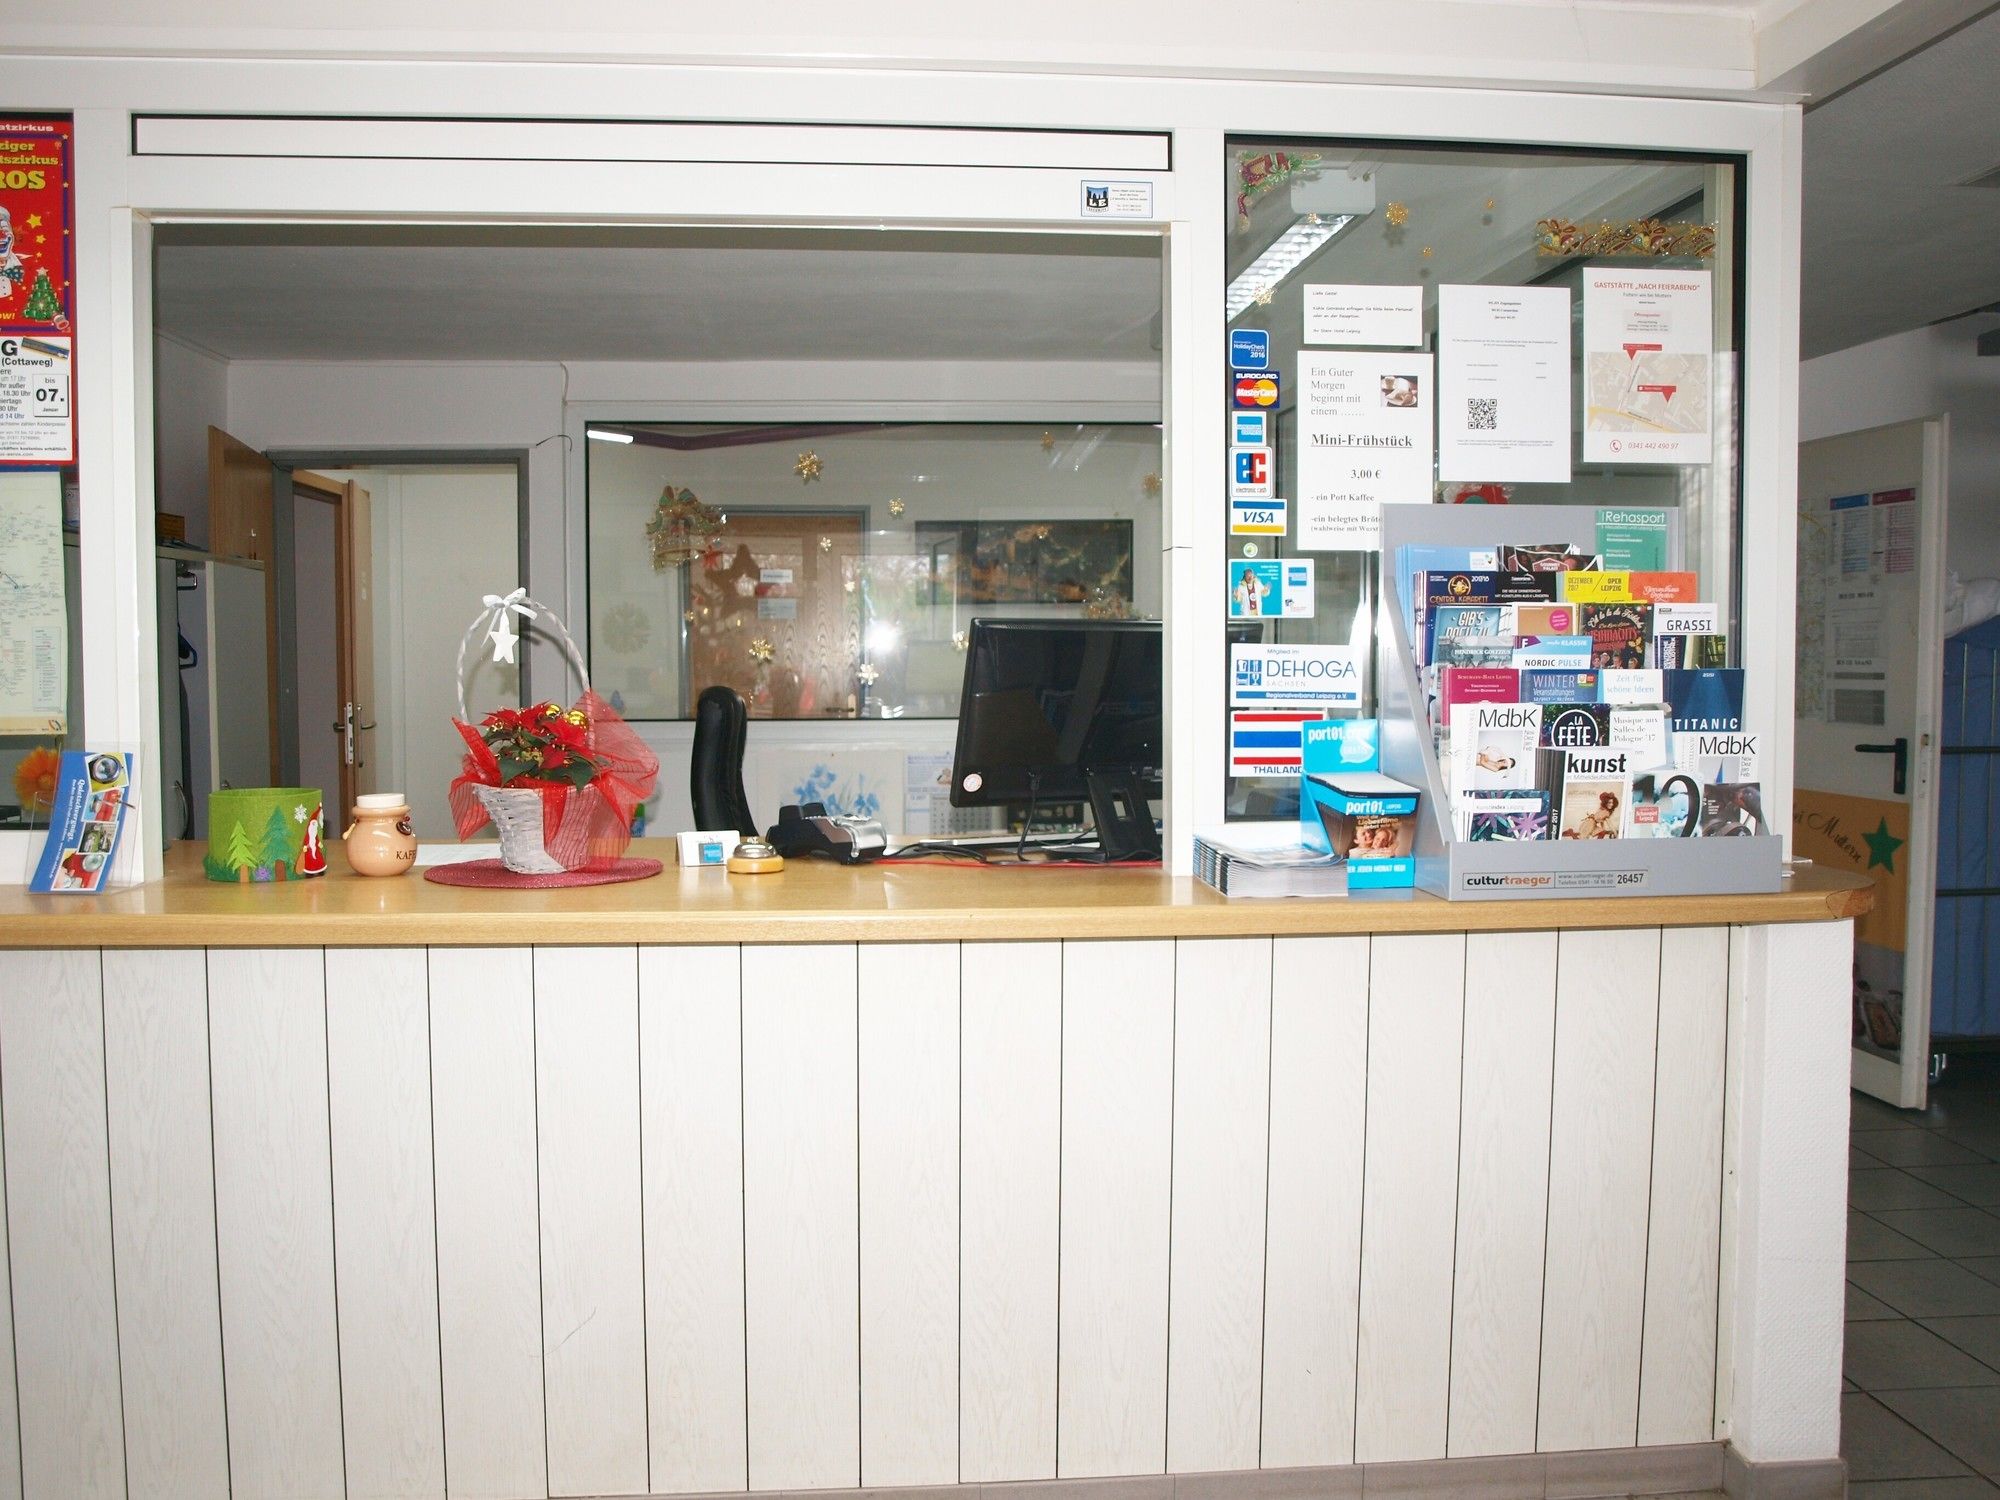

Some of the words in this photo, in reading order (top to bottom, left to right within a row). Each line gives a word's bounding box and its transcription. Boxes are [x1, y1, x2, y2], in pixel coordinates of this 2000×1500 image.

[1234, 343, 1265, 351] HolidayCheck
[1250, 351, 1266, 359] 2016
[1, 357, 53, 367] (Cottaweg)
[1311, 367, 1326, 376] Ein
[1328, 367, 1354, 377] Guter
[1311, 380, 1346, 391] Morgen
[36, 388, 65, 402] 07.
[1311, 393, 1344, 405] beginnt
[1346, 394, 1361, 403] mit
[1311, 408, 1338, 416] einem
[1311, 434, 1413, 447] Mini-Frühstück
[1375, 469, 1382, 479] €
[1316, 493, 1328, 501] ein
[1330, 493, 1347, 501] Pott
[1349, 493, 1375, 502] Kaffee
[1243, 511, 1274, 524] VISA
[1328, 514, 1359, 524] belegtes
[1605, 511, 1665, 524] Rehasport
[1666, 619, 1712, 631] GRASSI
[1525, 659, 1556, 667] NORDIC
[1558, 659, 1582, 667] PULSE
[1266, 660, 1356, 678] DEHOGA
[1533, 674, 1575, 688] WINTER
[1633, 673, 1644, 681] für
[1634, 685, 1655, 693] Ideen
[1479, 708, 1538, 728] MdbK
[1574, 715, 1583, 725] LA
[1613, 716, 1643, 725] Musique
[1674, 718, 1739, 731] TITANIC
[1558, 722, 1591, 745] FÊTE
[1614, 735, 1643, 743] Pologne
[1699, 736, 1757, 755] MdbK
[1567, 753, 1627, 773] kunst
[1467, 875, 1552, 887] culturtraeger
[1617, 873, 1644, 884] 26457
